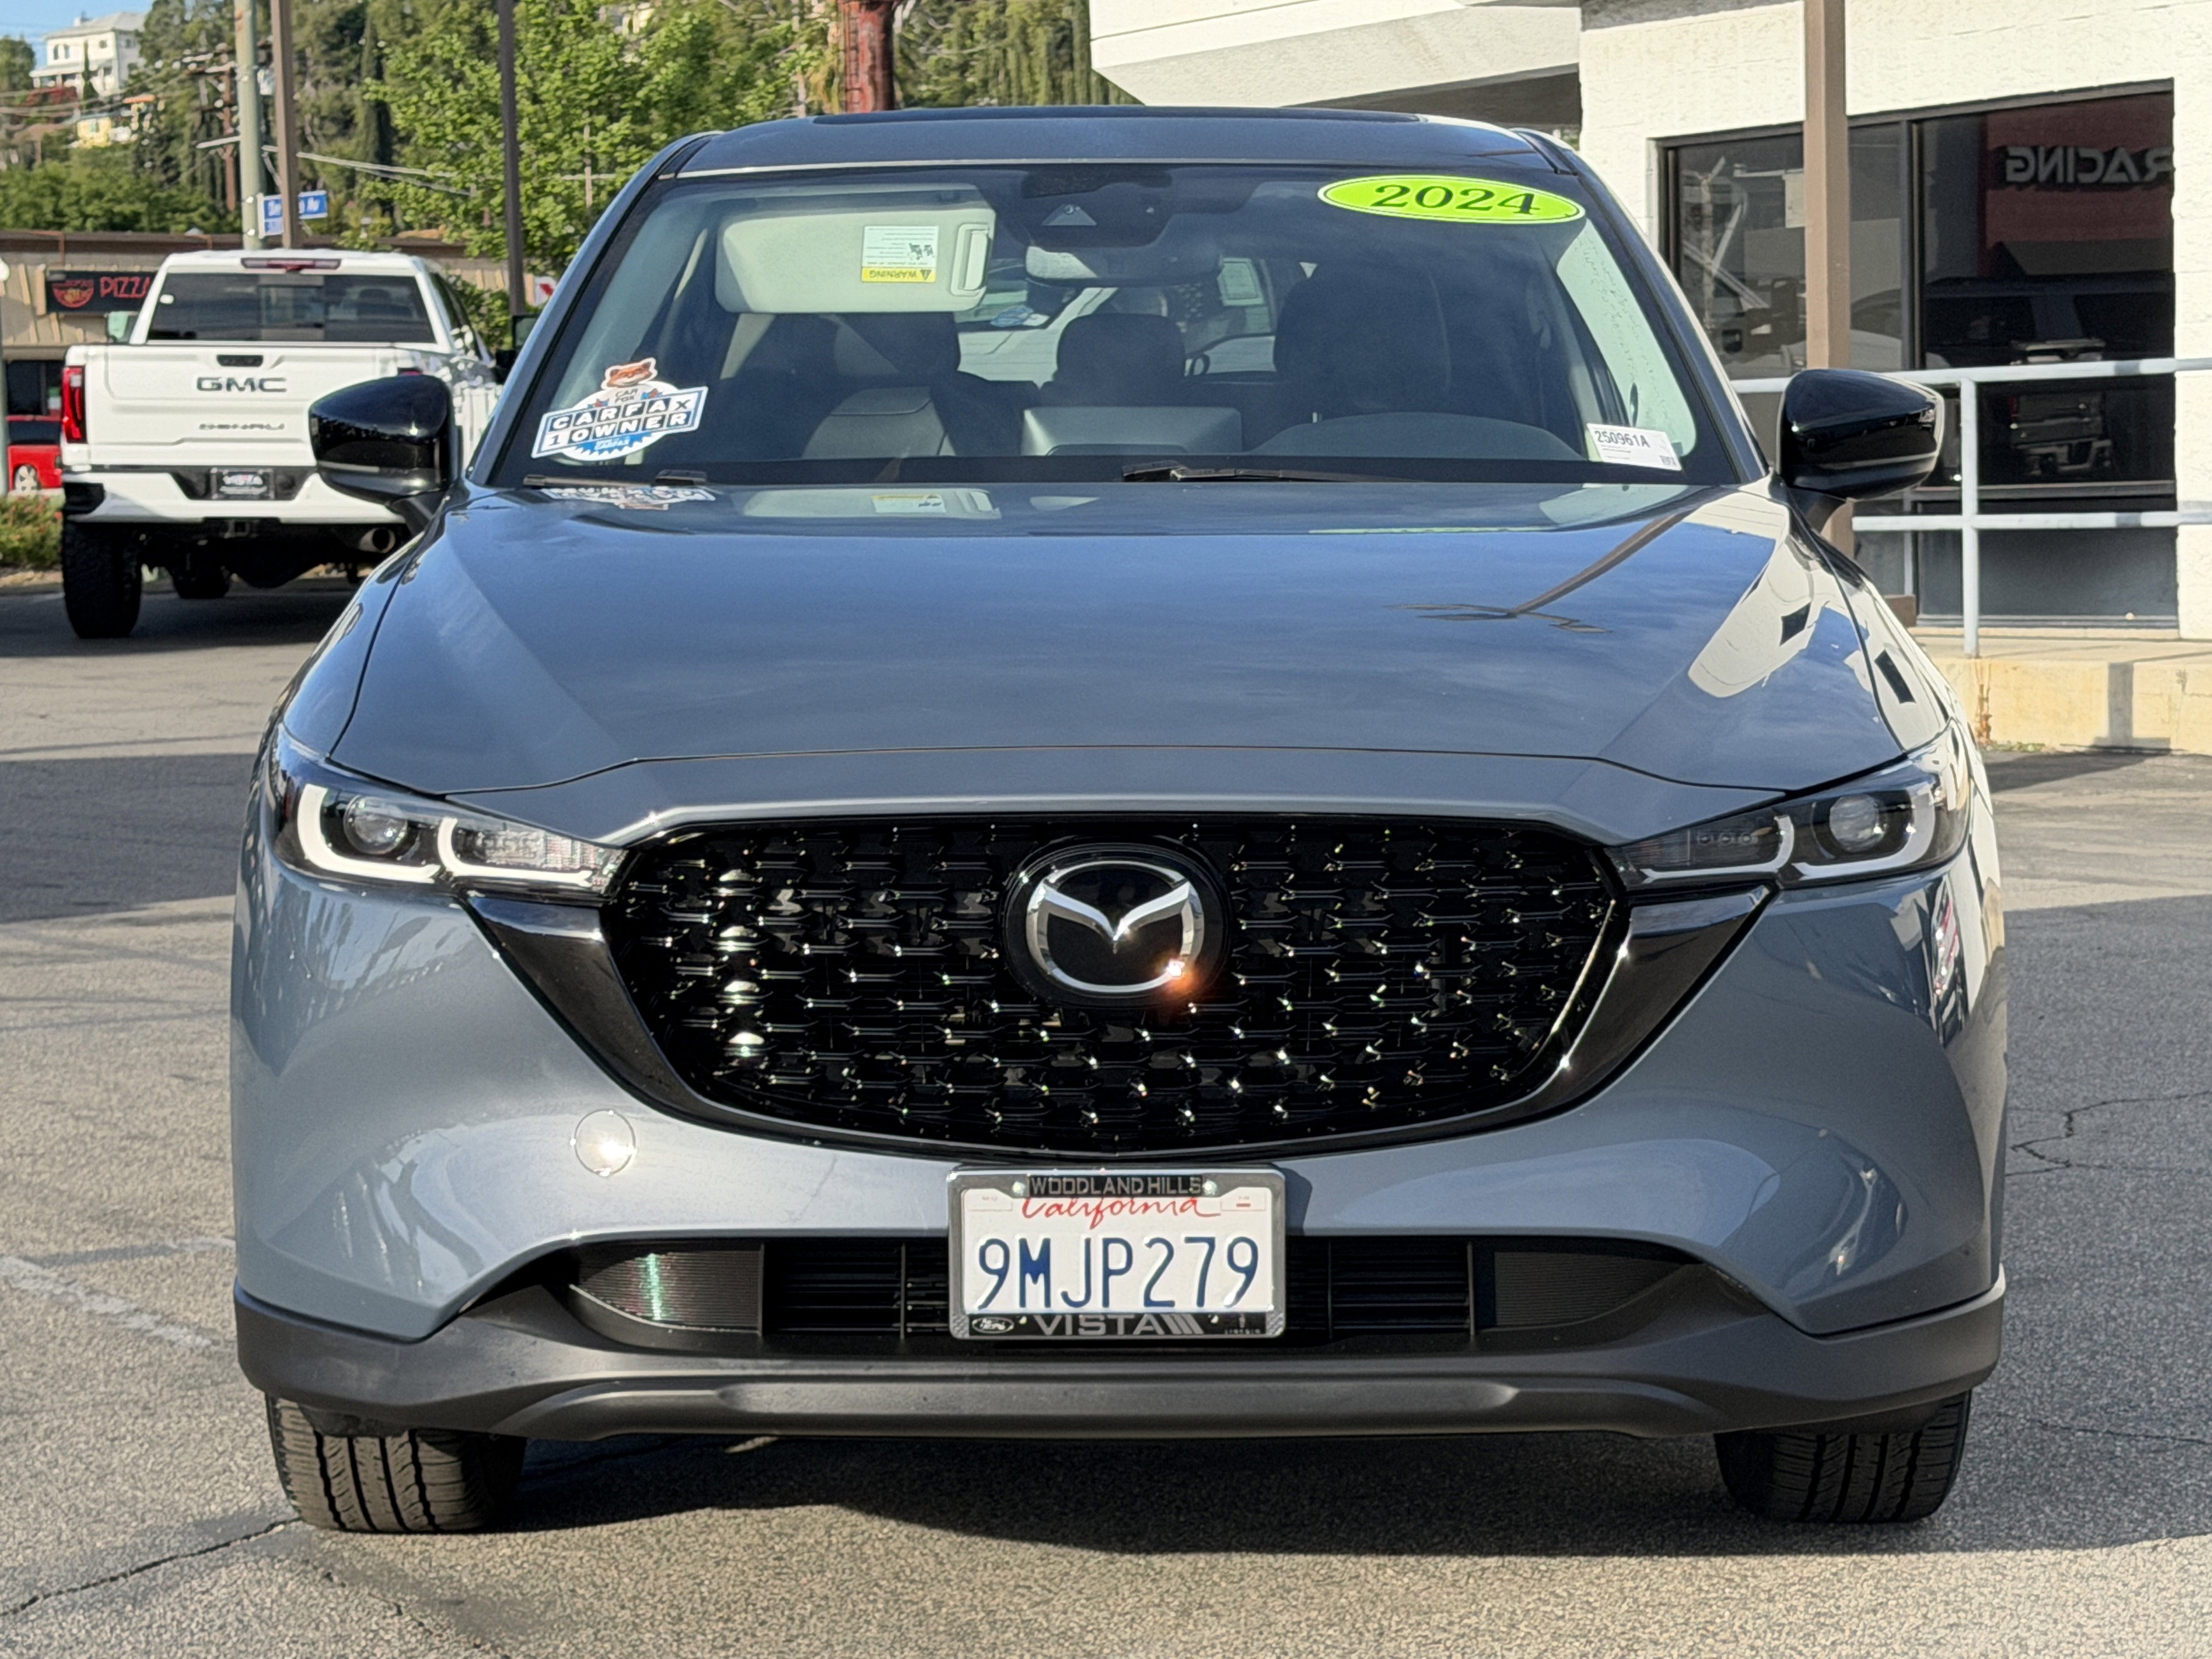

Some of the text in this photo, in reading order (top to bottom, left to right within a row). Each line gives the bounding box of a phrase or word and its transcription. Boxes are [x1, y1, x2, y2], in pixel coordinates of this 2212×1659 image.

[1370, 184, 1541, 216] 2024
[868, 269, 917, 279] WARNING
[196, 376, 287, 393] GMC
[615, 388, 639, 398] CAR
[552, 398, 691, 430] CARFAX
[549, 413, 687, 445] 1 OWNER
[1594, 430, 1651, 448] 250961A
[1031, 1176, 1201, 1195] WOODLAND HILLS
[1022, 1197, 1221, 1229] California
[978, 1236, 1259, 1310] 9MJP279
[1035, 1314, 1165, 1335] VISTA
